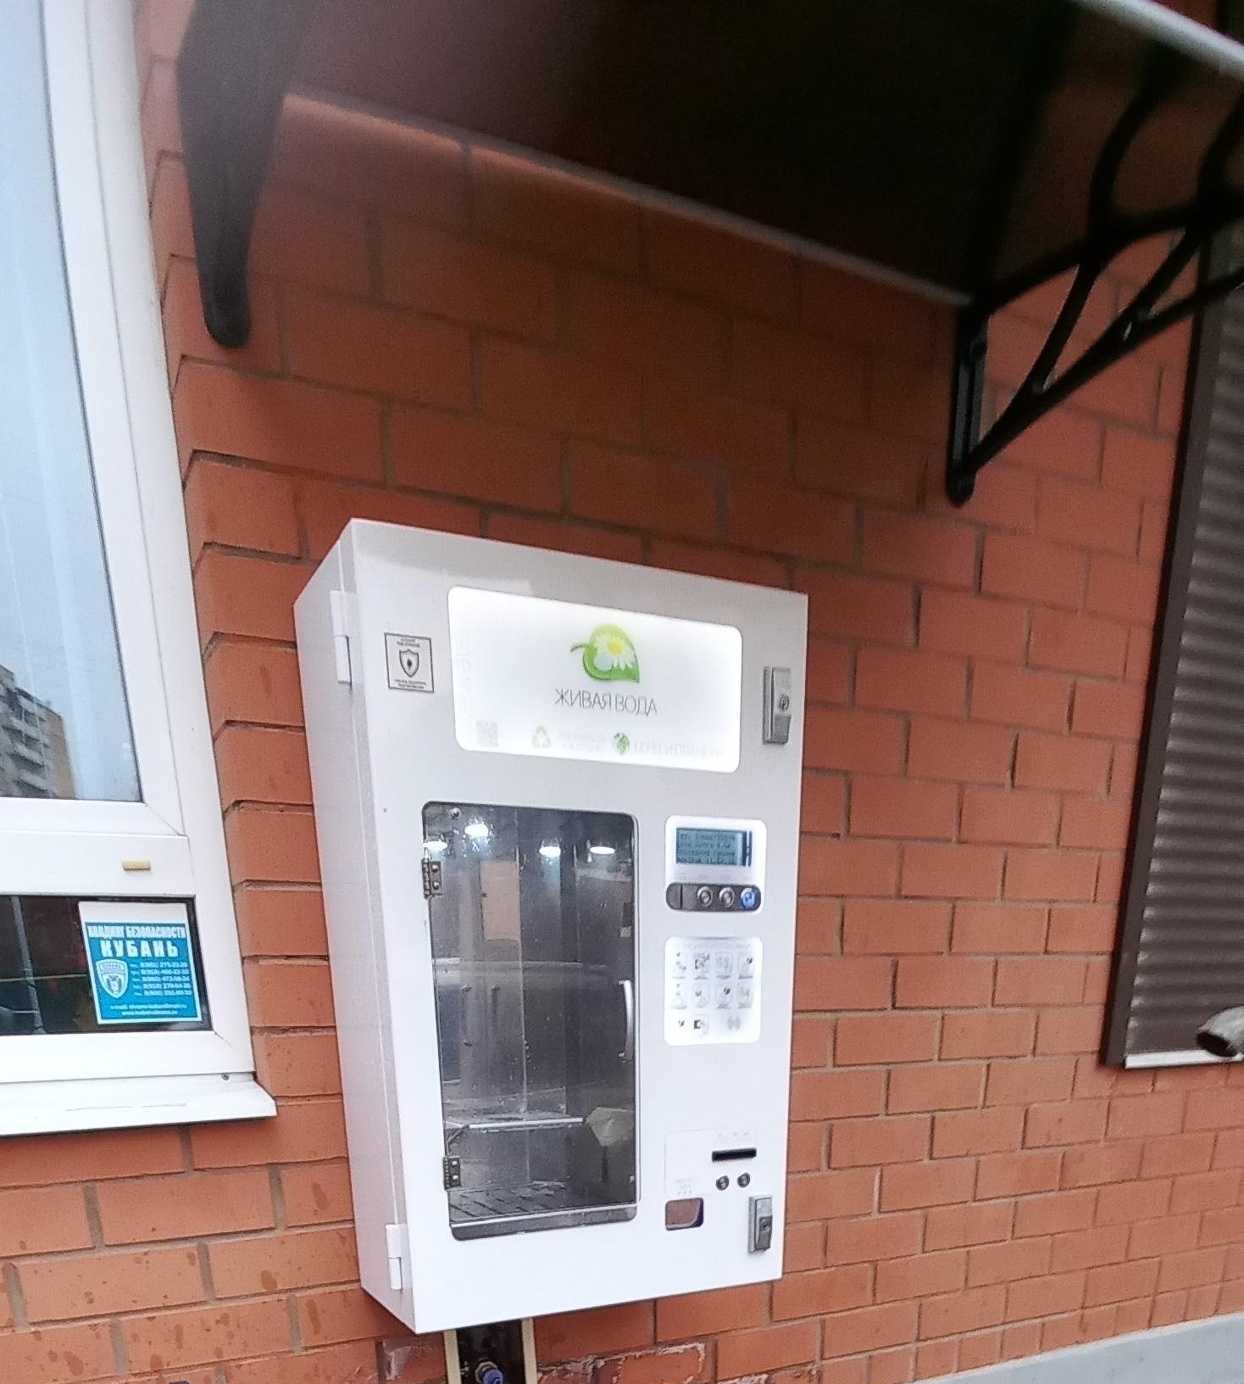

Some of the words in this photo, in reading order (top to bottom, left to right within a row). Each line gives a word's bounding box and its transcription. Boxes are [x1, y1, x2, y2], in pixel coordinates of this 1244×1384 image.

[554, 688, 612, 710] ЖИВАЯ
[614, 695, 658, 716] ВОДА
[100, 939, 179, 958] КУБАНЬ
